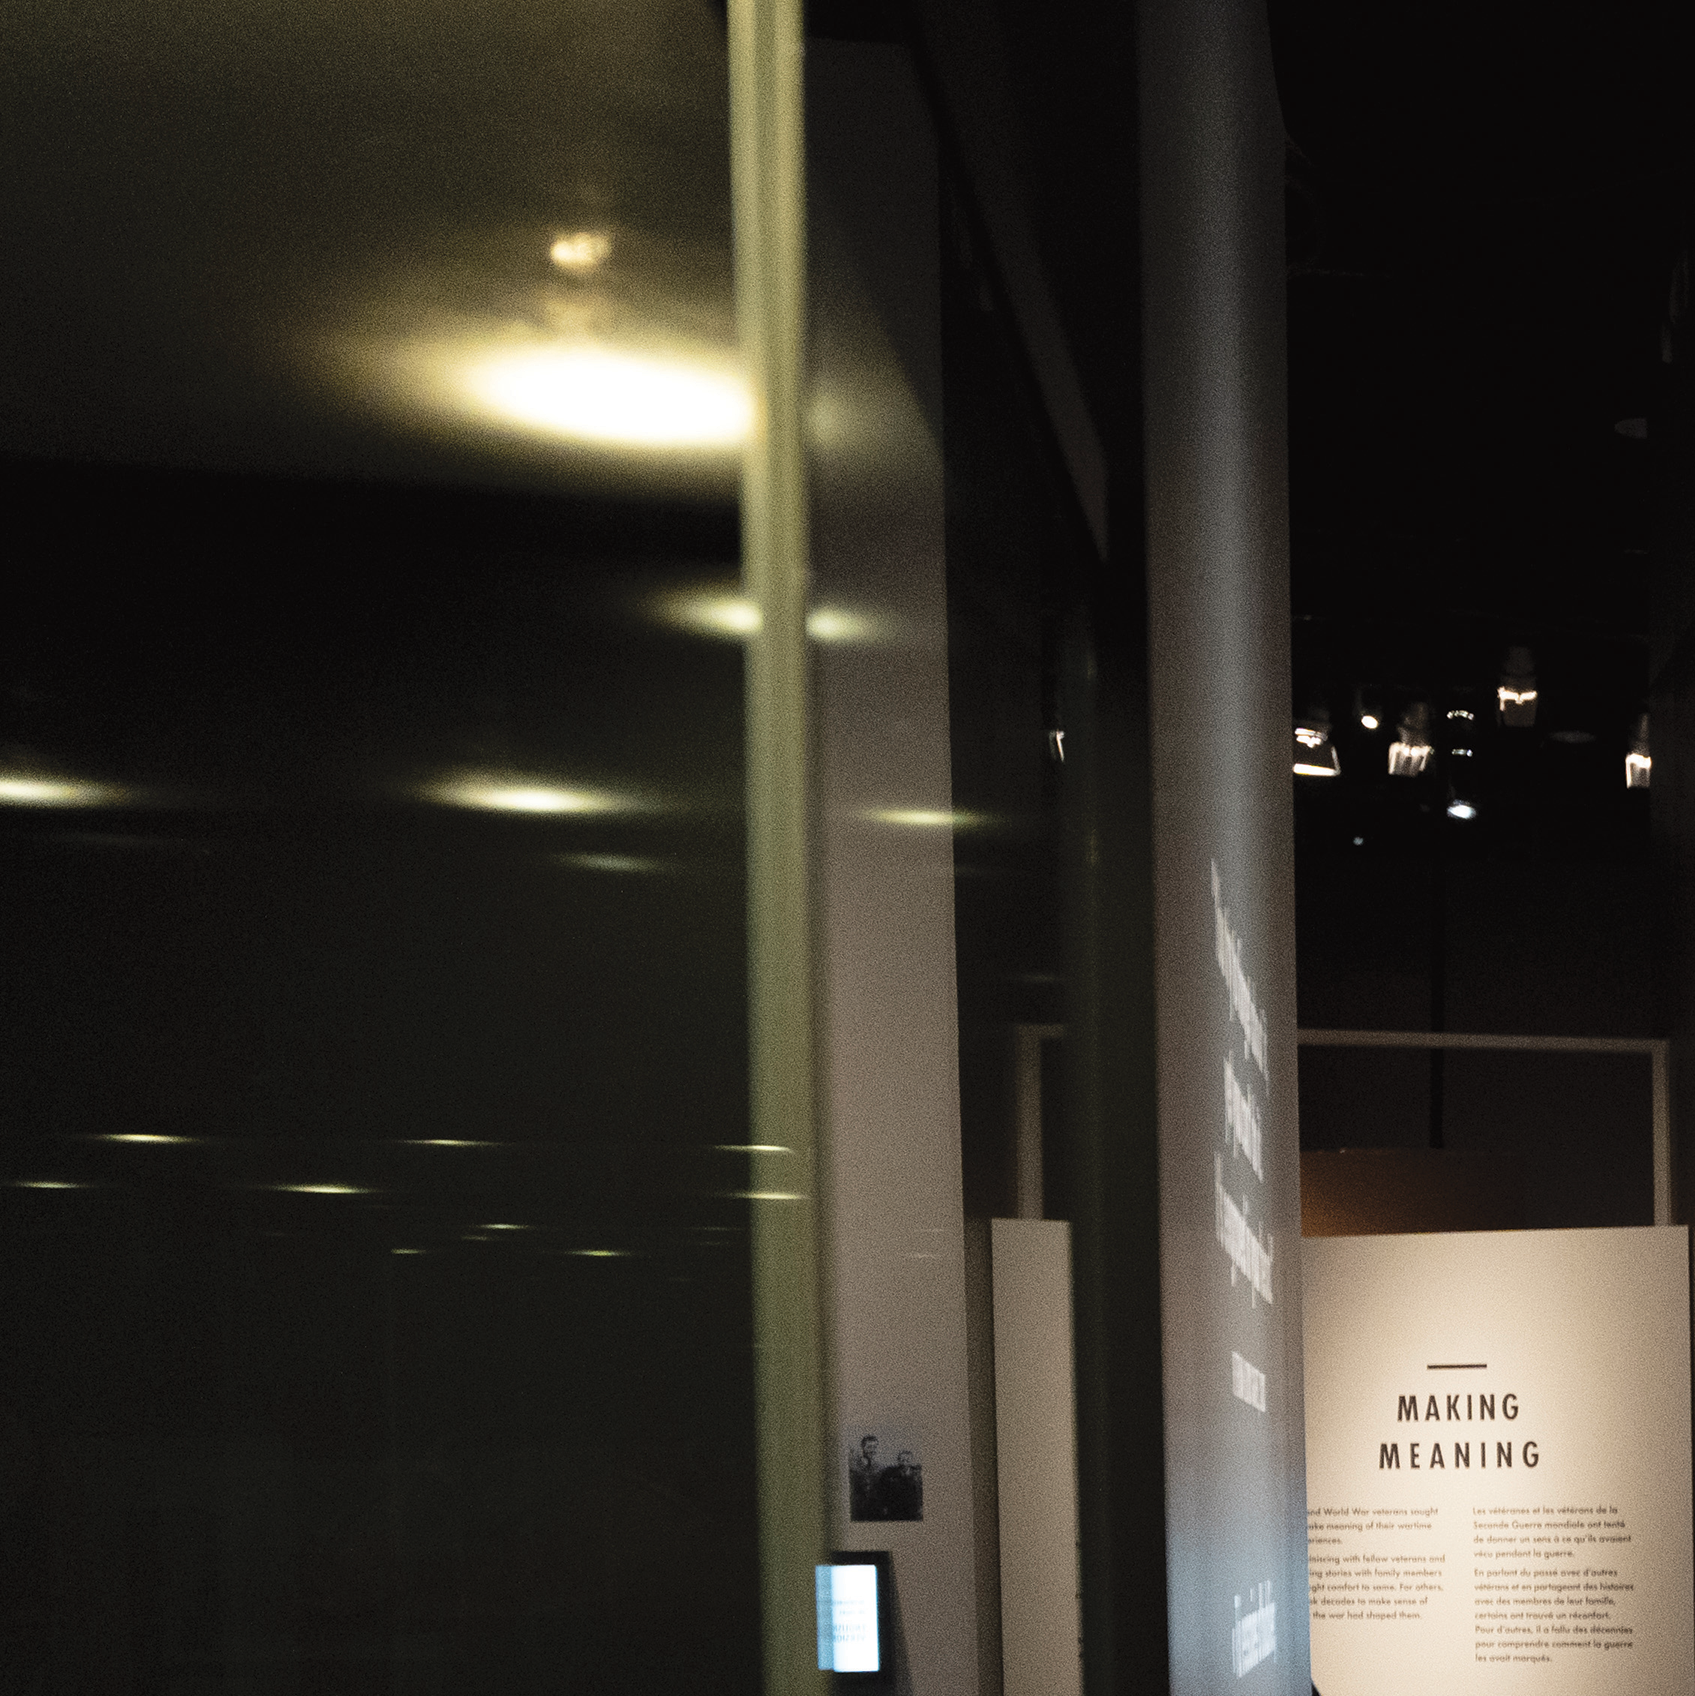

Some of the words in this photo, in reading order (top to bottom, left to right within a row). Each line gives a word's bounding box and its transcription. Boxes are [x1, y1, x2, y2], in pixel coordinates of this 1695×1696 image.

[1397, 1393, 1519, 1422] MAKING
[1379, 1441, 1539, 1469] MEANING
[1324, 1508, 1349, 1516] World
[1372, 1508, 1407, 1516] veterans
[1411, 1507, 1438, 1517] sought
[1543, 1506, 1554, 1514] les
[1596, 1506, 1607, 1514] de
[1326, 1522, 1363, 1532] meaning
[1366, 1521, 1374, 1529] of
[1376, 1521, 1394, 1529] their
[1397, 1521, 1431, 1529] wartime
[1512, 1520, 1542, 1528] Guerre
[1545, 1520, 1584, 1528] mondiale
[1343, 1554, 1360, 1563] with
[1363, 1554, 1388, 1563] fellow
[1391, 1554, 1426, 1563] veterans
[1429, 1554, 1445, 1563] and
[1496, 1550, 1530, 1559] pendant
[1325, 1568, 1352, 1577] stories
[1355, 1568, 1372, 1577] with
[1375, 1568, 1400, 1579] family
[1403, 1568, 1442, 1577] members
[1474, 1567, 1484, 1577] En
[1487, 1567, 1517, 1578] parlant
[1520, 1567, 1530, 1577] du
[1534, 1567, 1558, 1578] passé
[1327, 1582, 1359, 1591] comfort
[1362, 1583, 1369, 1591] to
[1534, 1583, 1581, 1592] partageant
[1321, 1596, 1355, 1605] decades
[1358, 1597, 1366, 1605] to
[1368, 1597, 1391, 1605] make
[1419, 1596, 1428, 1605] of
[1513, 1596, 1552, 1605] membres
[1313, 1610, 1326, 1619] the
[1347, 1611, 1363, 1619] had
[1366, 1610, 1396, 1621] shaped
